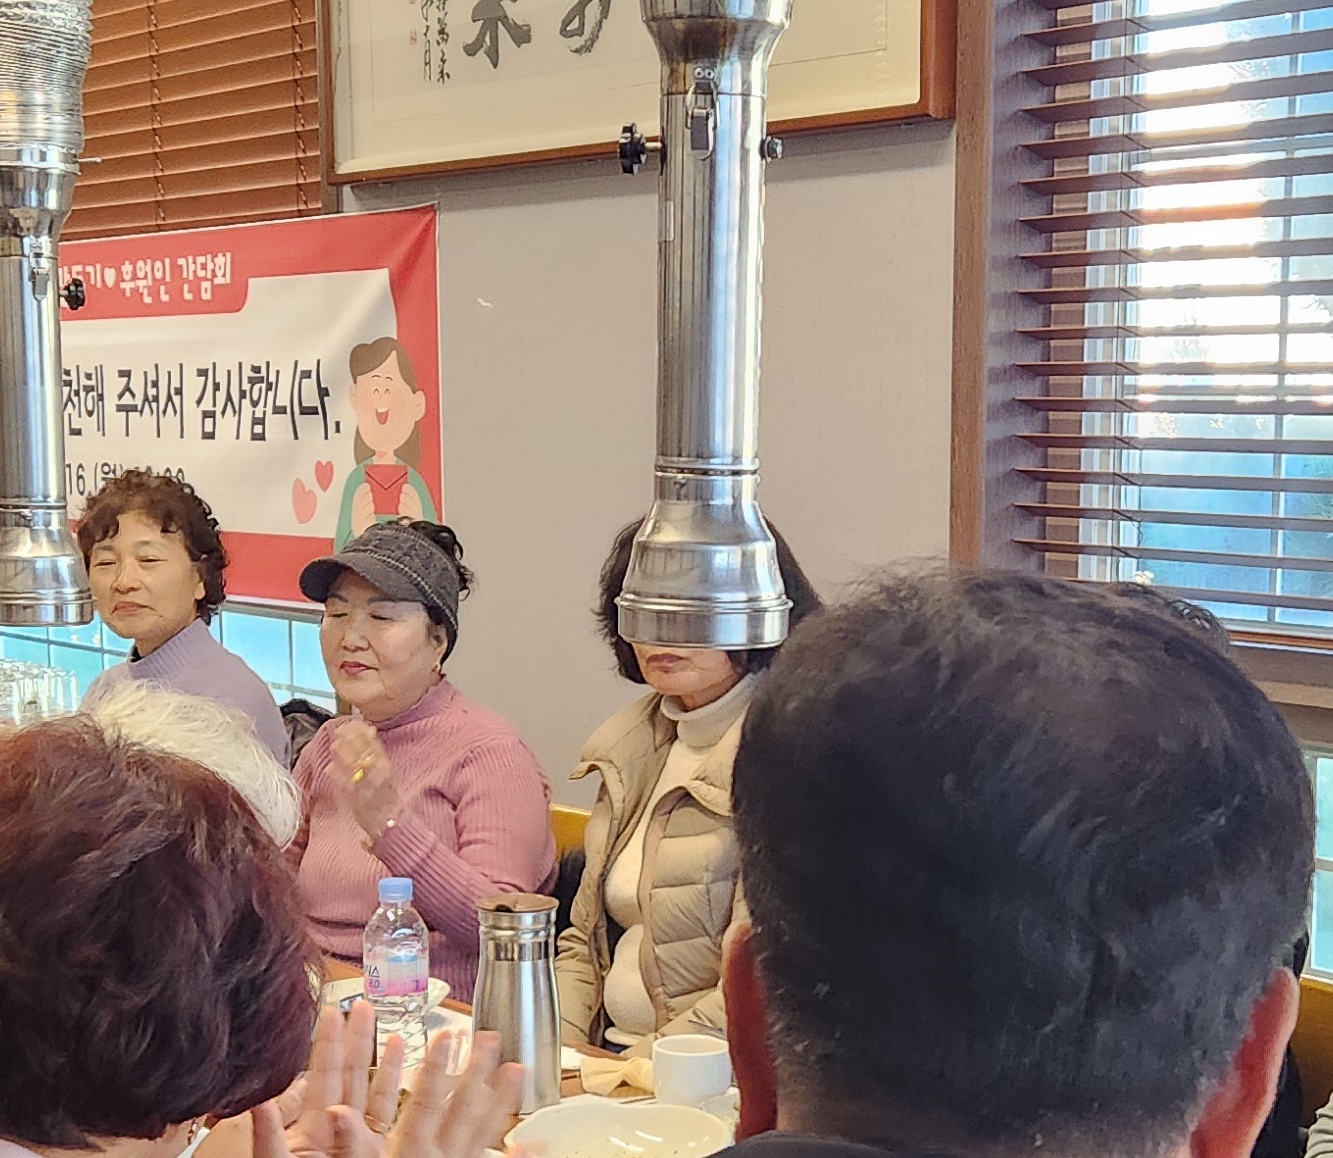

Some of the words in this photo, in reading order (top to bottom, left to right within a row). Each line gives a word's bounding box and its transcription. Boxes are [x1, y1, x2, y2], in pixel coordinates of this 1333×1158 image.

[120, 257, 170, 304] 후원인
[177, 251, 232, 300] 간담회
[62, 364, 106, 437] 천해
[115, 362, 184, 439] 주셔서
[195, 358, 341, 442] 감사합니다.
